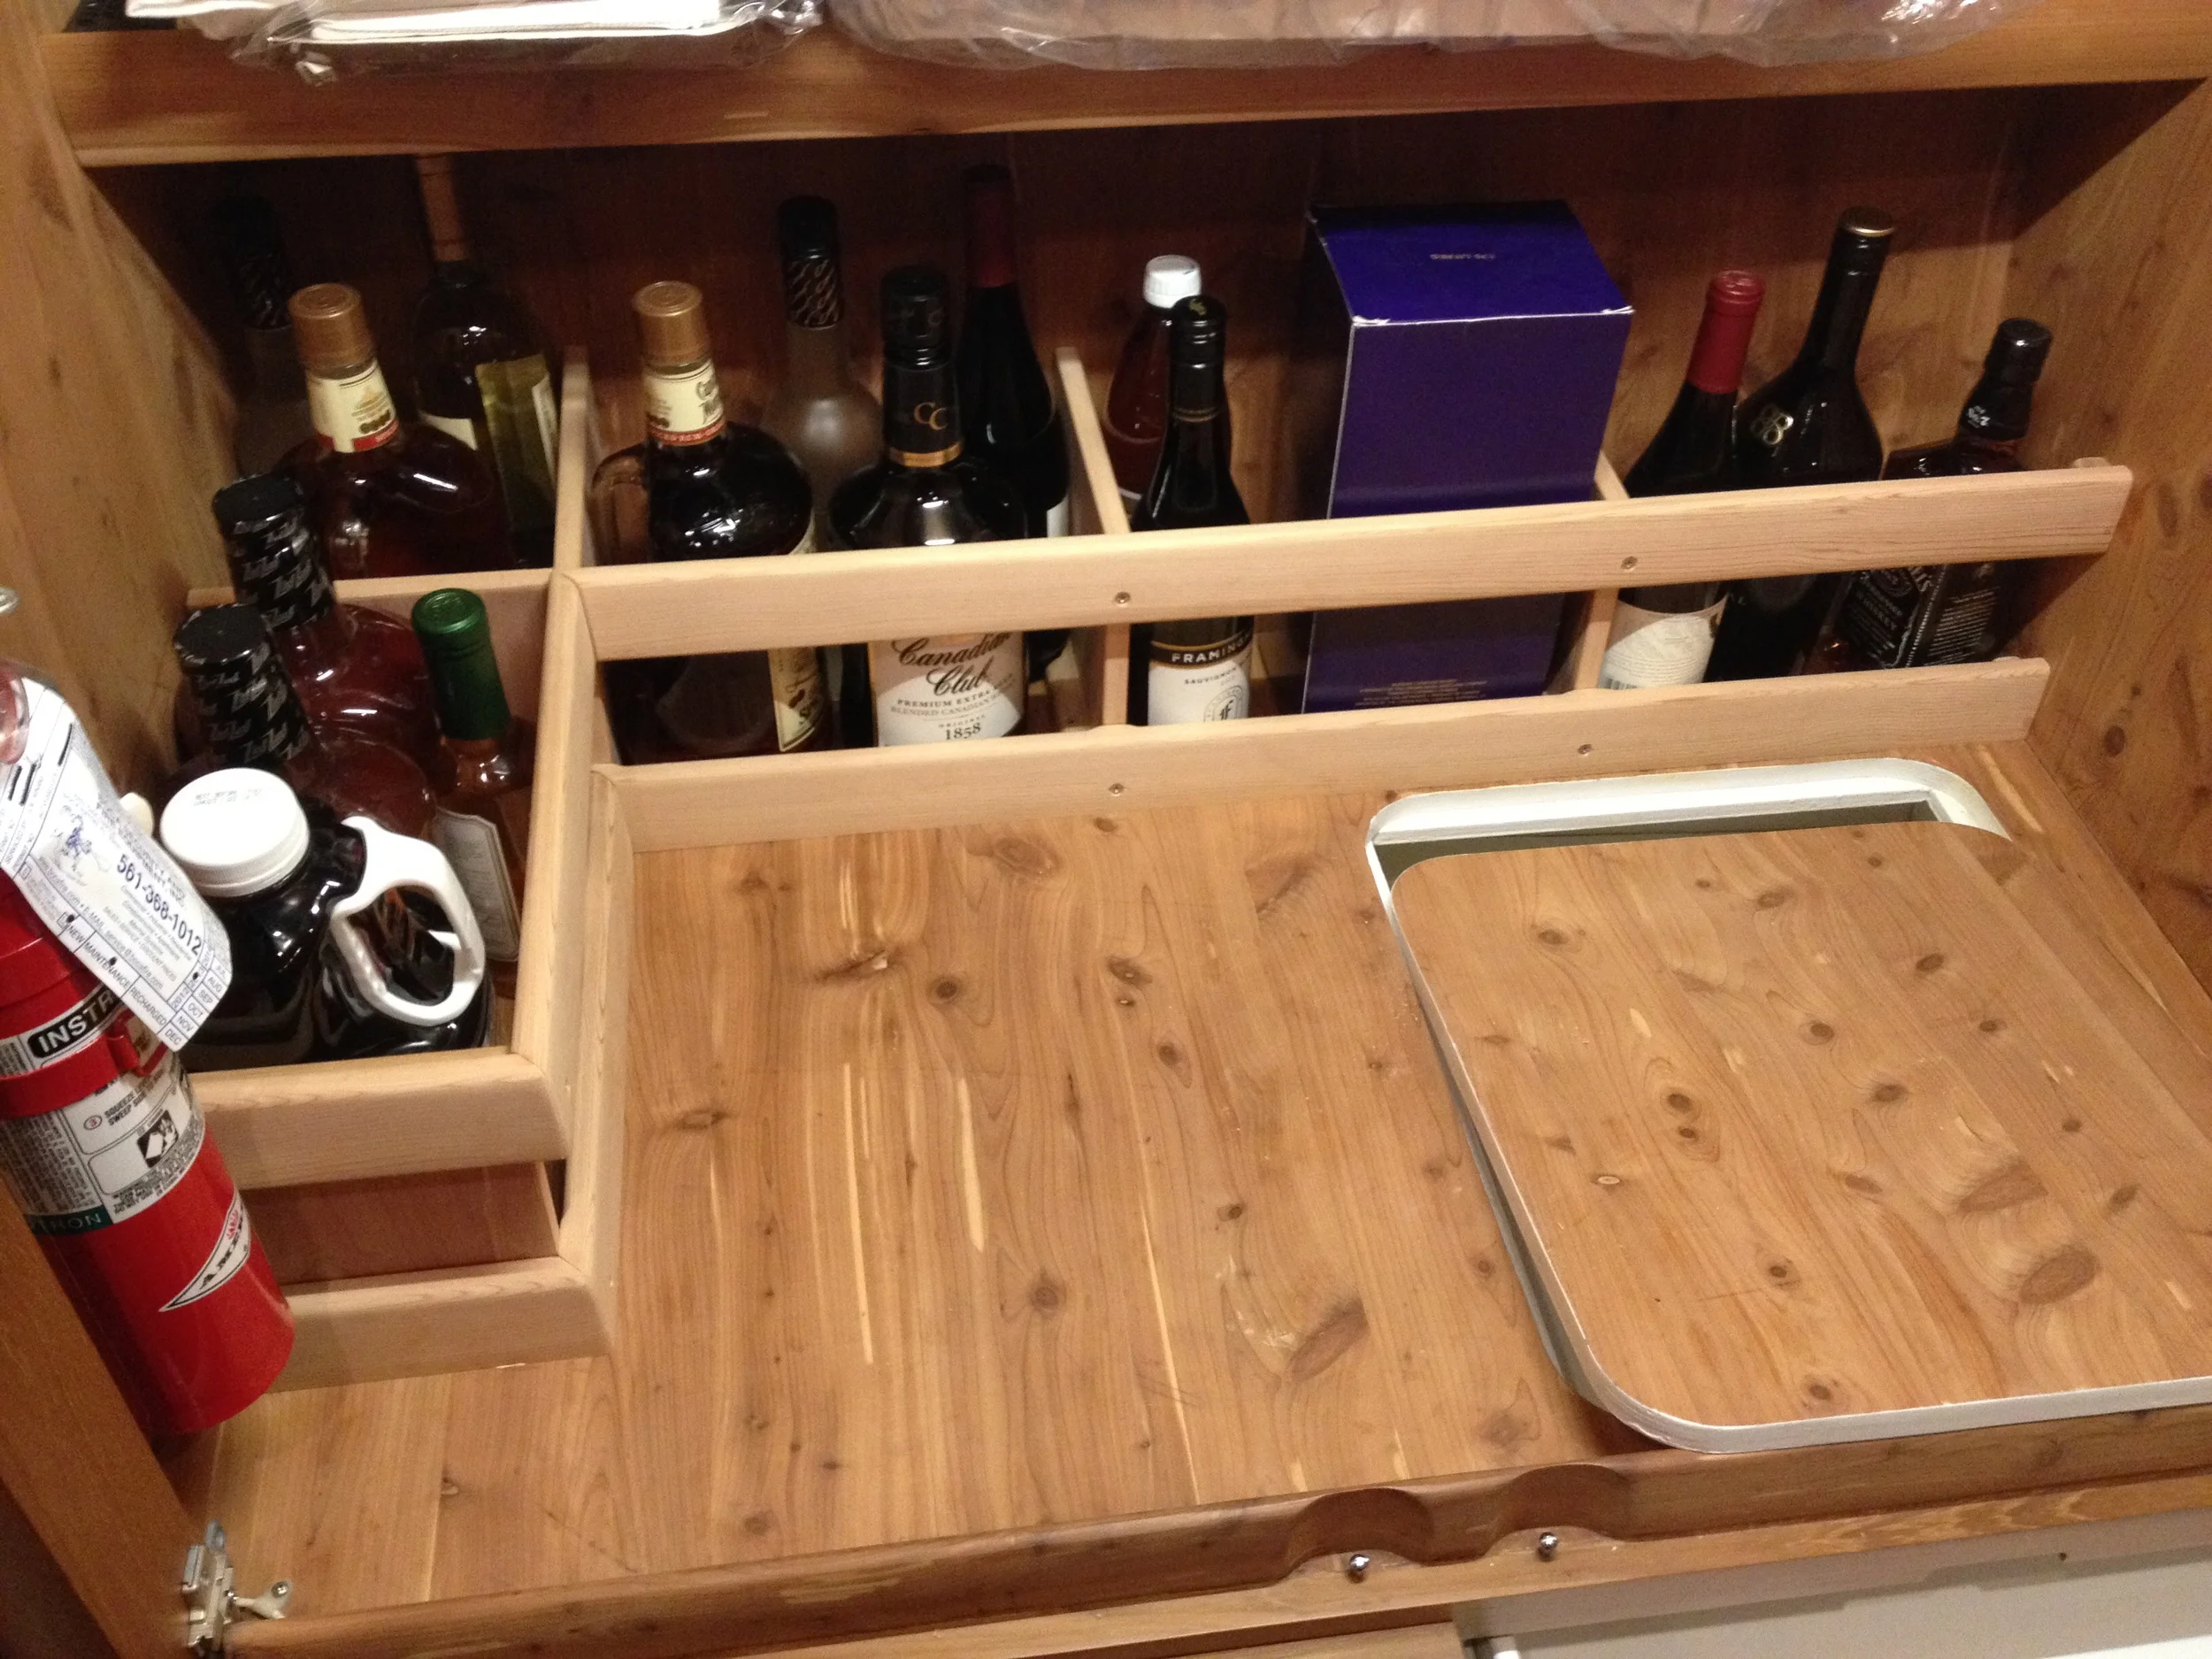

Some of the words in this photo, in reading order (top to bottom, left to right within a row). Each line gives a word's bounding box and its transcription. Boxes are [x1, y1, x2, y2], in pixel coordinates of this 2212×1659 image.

[1171, 633, 1249, 664] FRAMING
[926, 656, 994, 696] Club
[896, 698, 953, 708] PREMIUM
[944, 722, 982, 741] 1858
[116, 854, 201, 956] 561-368-1012
[65, 925, 85, 945] NEW
[81, 941, 132, 990] MAINTENANCE
[206, 975, 224, 993] AUG
[127, 987, 167, 1026] RECHARGED
[197, 989, 213, 1005] SEP
[186, 1002, 204, 1019] OCT
[38, 989, 114, 1053] INSTR
[176, 1015, 194, 1033] NOV
[164, 1027, 181, 1046] DEC
